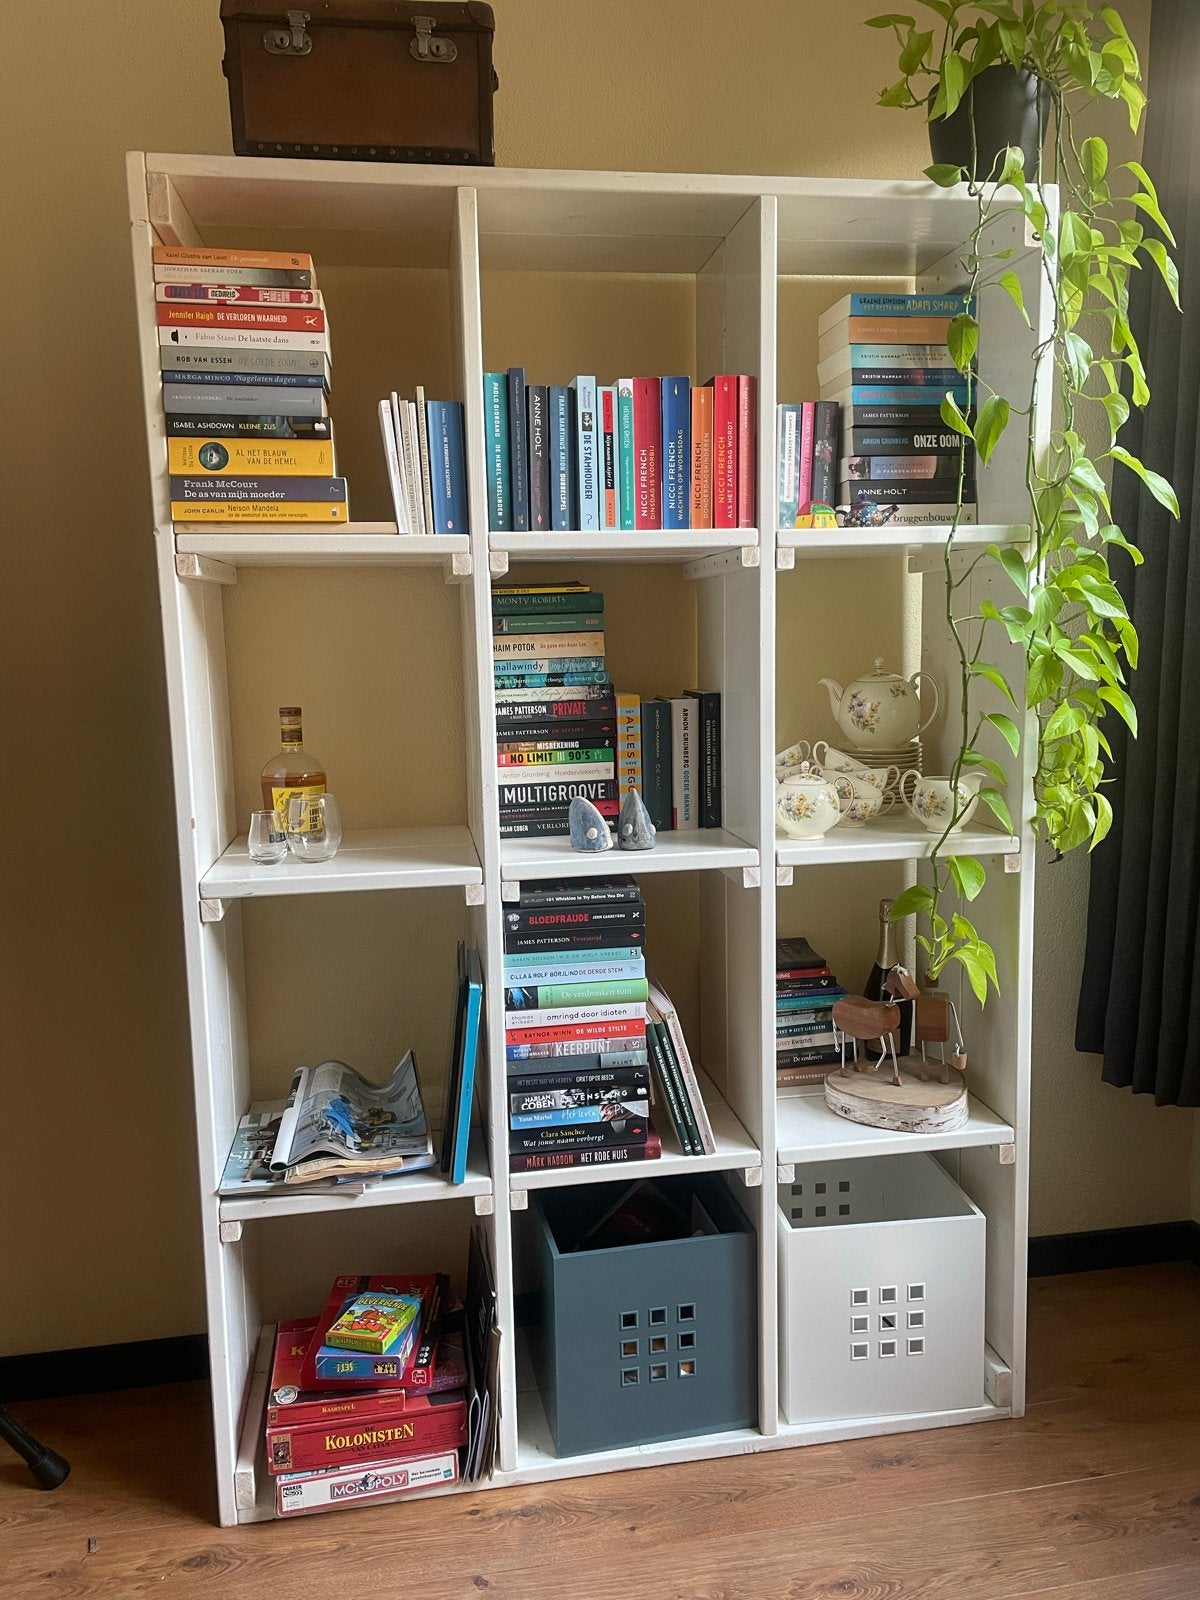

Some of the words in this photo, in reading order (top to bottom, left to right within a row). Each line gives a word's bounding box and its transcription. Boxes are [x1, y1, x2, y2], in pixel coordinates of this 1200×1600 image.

[169, 311, 194, 319] Jennifer
[195, 312, 213, 320] Haigh
[226, 314, 255, 322] VERLOREN
[257, 315, 287, 323] WAARHEID
[249, 335, 271, 343] laatste
[234, 375, 273, 383] Nagelaten
[493, 405, 501, 437] GIORDANO
[584, 435, 591, 444] DE
[914, 435, 937, 447] ONZE
[940, 435, 959, 447] OOM
[495, 445, 502, 453] DE
[584, 447, 592, 500] STAMHOUDER
[678, 473, 683, 483] OP
[228, 491, 248, 499] mijn
[493, 644, 510, 652] HAIM
[513, 643, 535, 651] POTOK
[494, 661, 543, 672] mallawindy
[515, 705, 546, 715] PATTERSON
[553, 702, 587, 715] PRIVATE
[537, 741, 579, 750] MISREKENING
[510, 754, 523, 763] NO
[527, 753, 553, 763] LIMIT
[569, 751, 590, 760] 90'S
[505, 783, 605, 804] MULTIGROOVE
[529, 914, 589, 925] BLOEDFRAUDE
[547, 1012, 578, 1021] omringd
[555, 1041, 611, 1055] KEERPUNT
[521, 1099, 555, 1110] COBEN
[525, 1095, 550, 1103] HARLAN
[577, 1135, 604, 1143] verbergt
[547, 1154, 574, 1165] HADDON
[581, 1153, 593, 1163] HET
[595, 1152, 611, 1161] RODE
[613, 1149, 628, 1160] HUIS
[325, 1423, 415, 1451] KOLONISTEN
[333, 1472, 406, 1497] MONOPOLY
